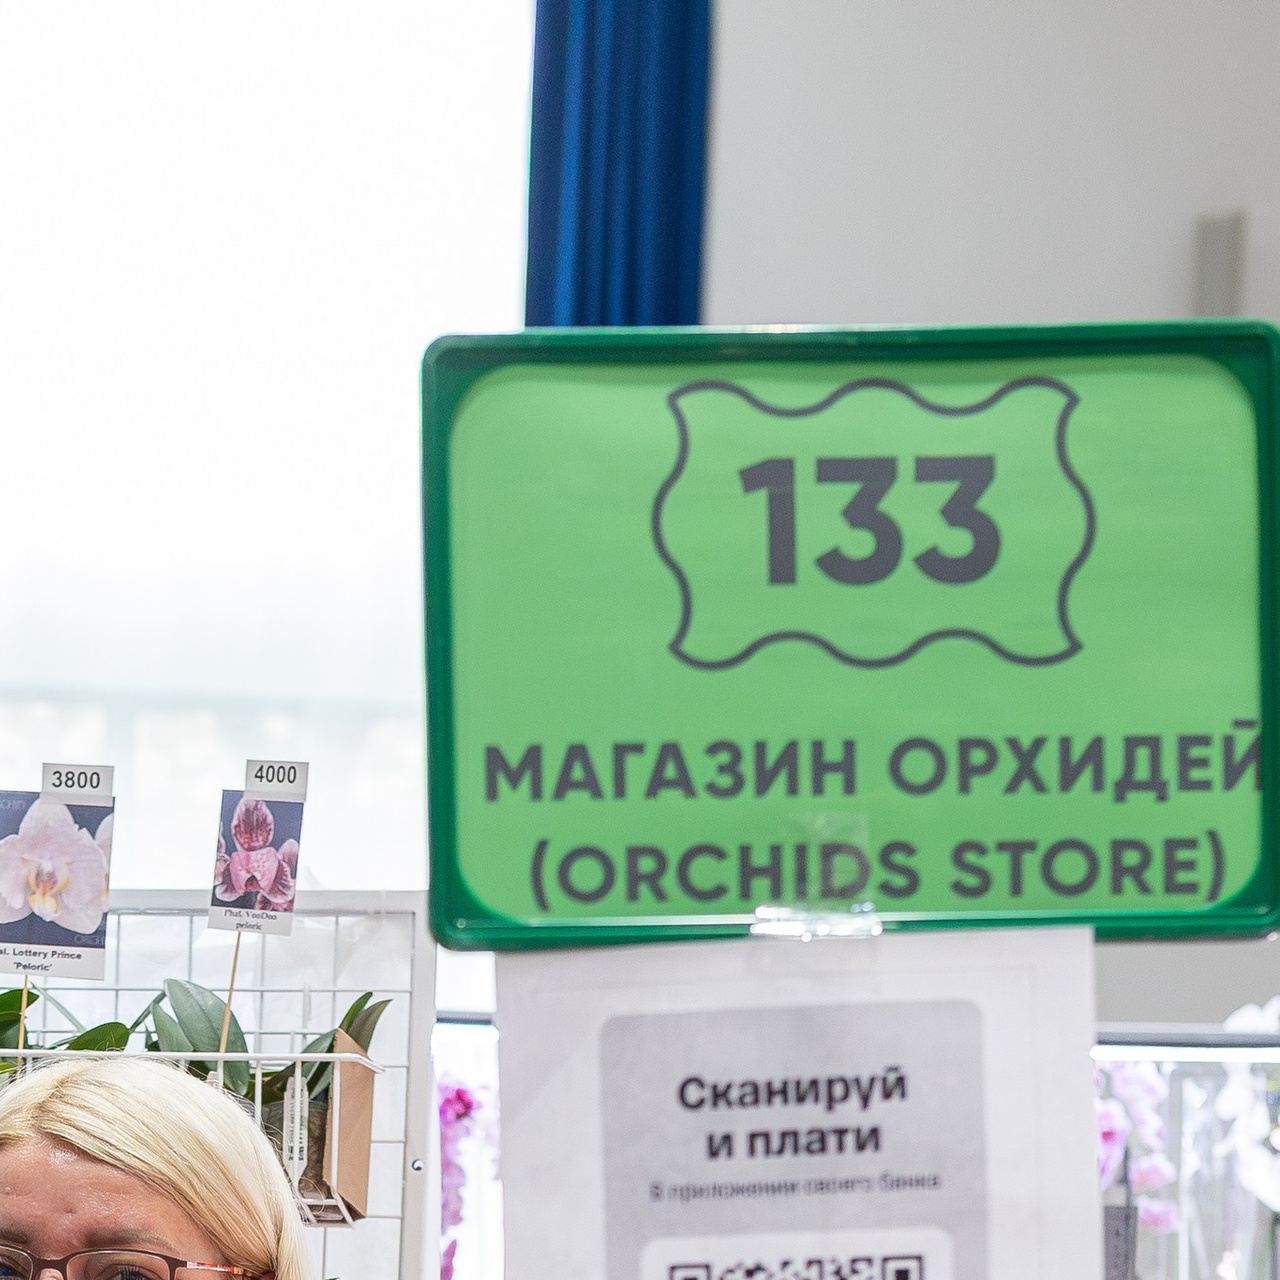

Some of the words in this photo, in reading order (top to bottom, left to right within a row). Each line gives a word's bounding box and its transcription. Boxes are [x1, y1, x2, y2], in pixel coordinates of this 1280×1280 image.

[738, 456, 1001, 585] 133
[51, 770, 100, 790] 3800
[254, 764, 297, 784] 4000
[484, 738, 857, 802] МАГАЗИН
[888, 719, 1263, 803] ОРХИДЕЙ
[530, 838, 922, 911] (ORCHIDS
[950, 830, 1225, 901] STORE)
[13, 948, 48, 961] Lottery
[51, 950, 82, 961] Prince
[677, 1065, 908, 1112] Сканируй
[707, 1132, 734, 1160] и
[747, 1124, 882, 1158] плати
